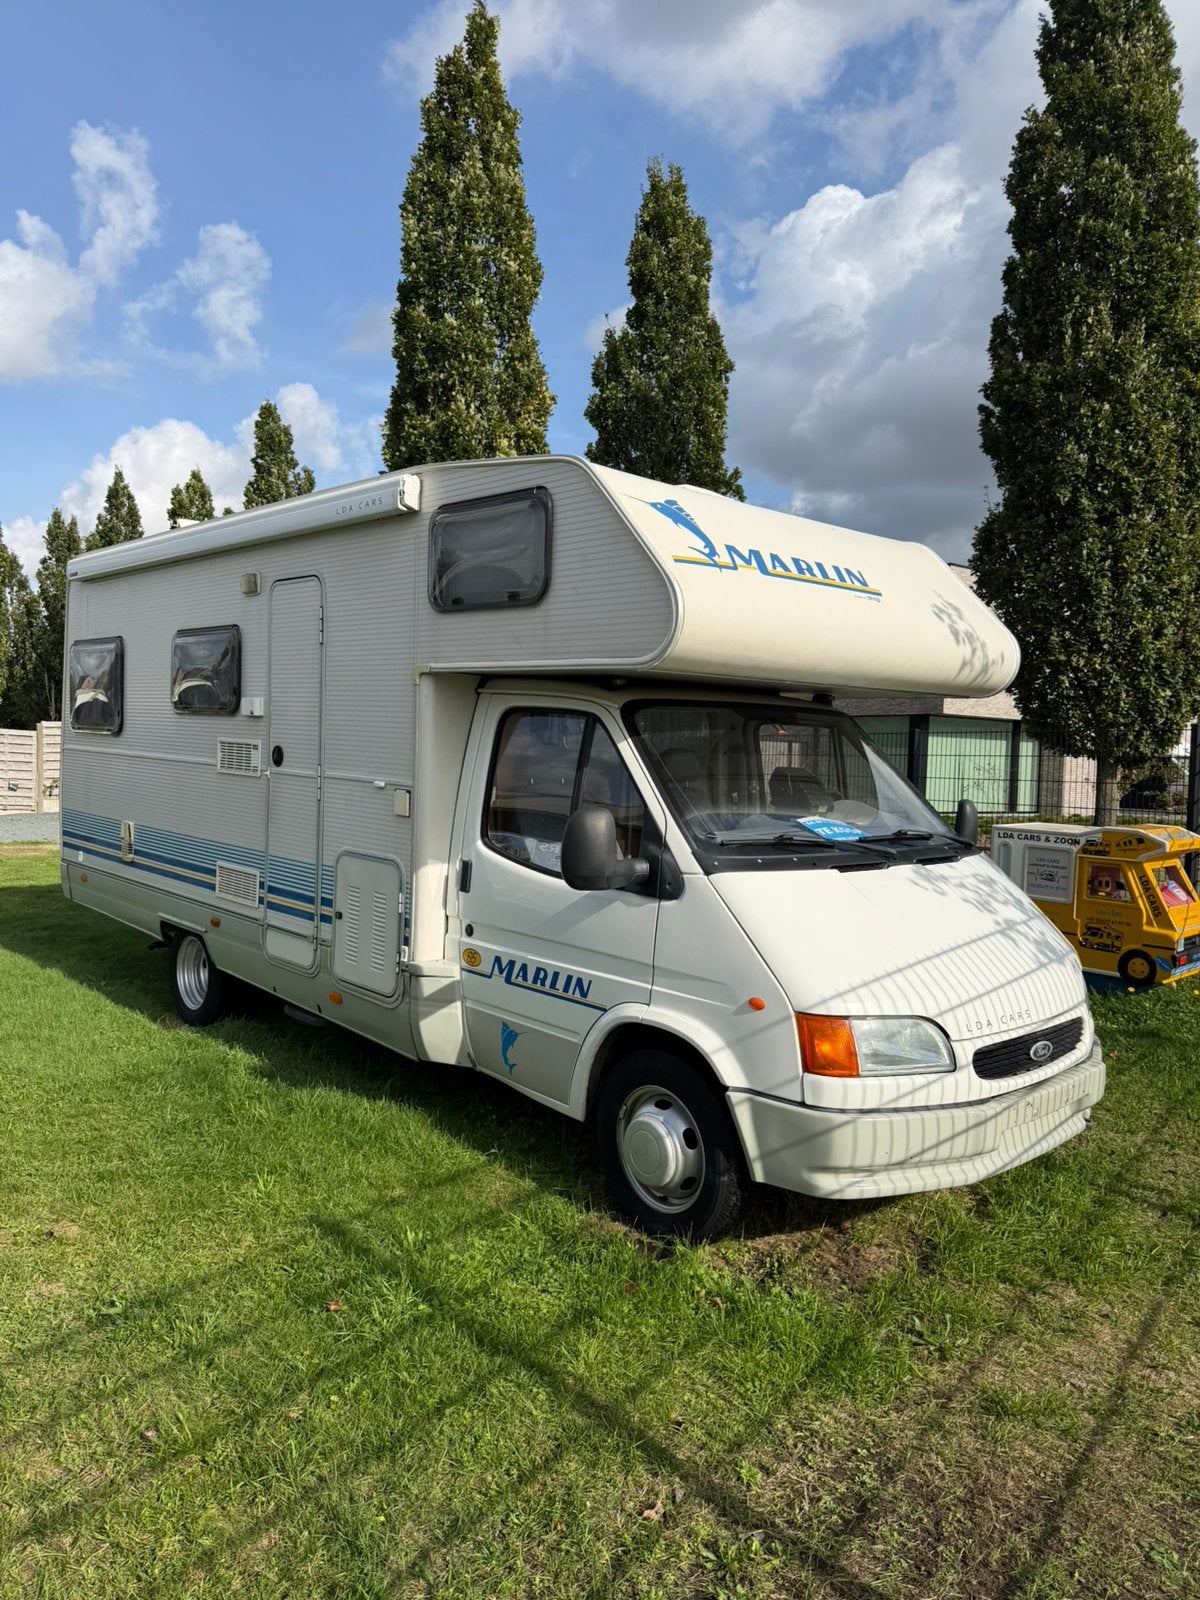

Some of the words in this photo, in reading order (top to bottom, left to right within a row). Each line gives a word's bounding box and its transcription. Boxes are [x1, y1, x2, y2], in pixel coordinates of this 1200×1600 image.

[336, 505, 353, 515] LDA
[358, 497, 383, 510] CARS
[724, 544, 869, 588] MARLIN
[998, 832, 1015, 840] LDA
[1017, 833, 1042, 842] CARS
[1054, 836, 1080, 846] ZOON
[1139, 875, 1151, 892] LDA
[1147, 894, 1162, 917] CARS
[490, 955, 593, 999] MARLIN
[966, 1019, 993, 1032] LDA
[1000, 1009, 1031, 1025] CARS
